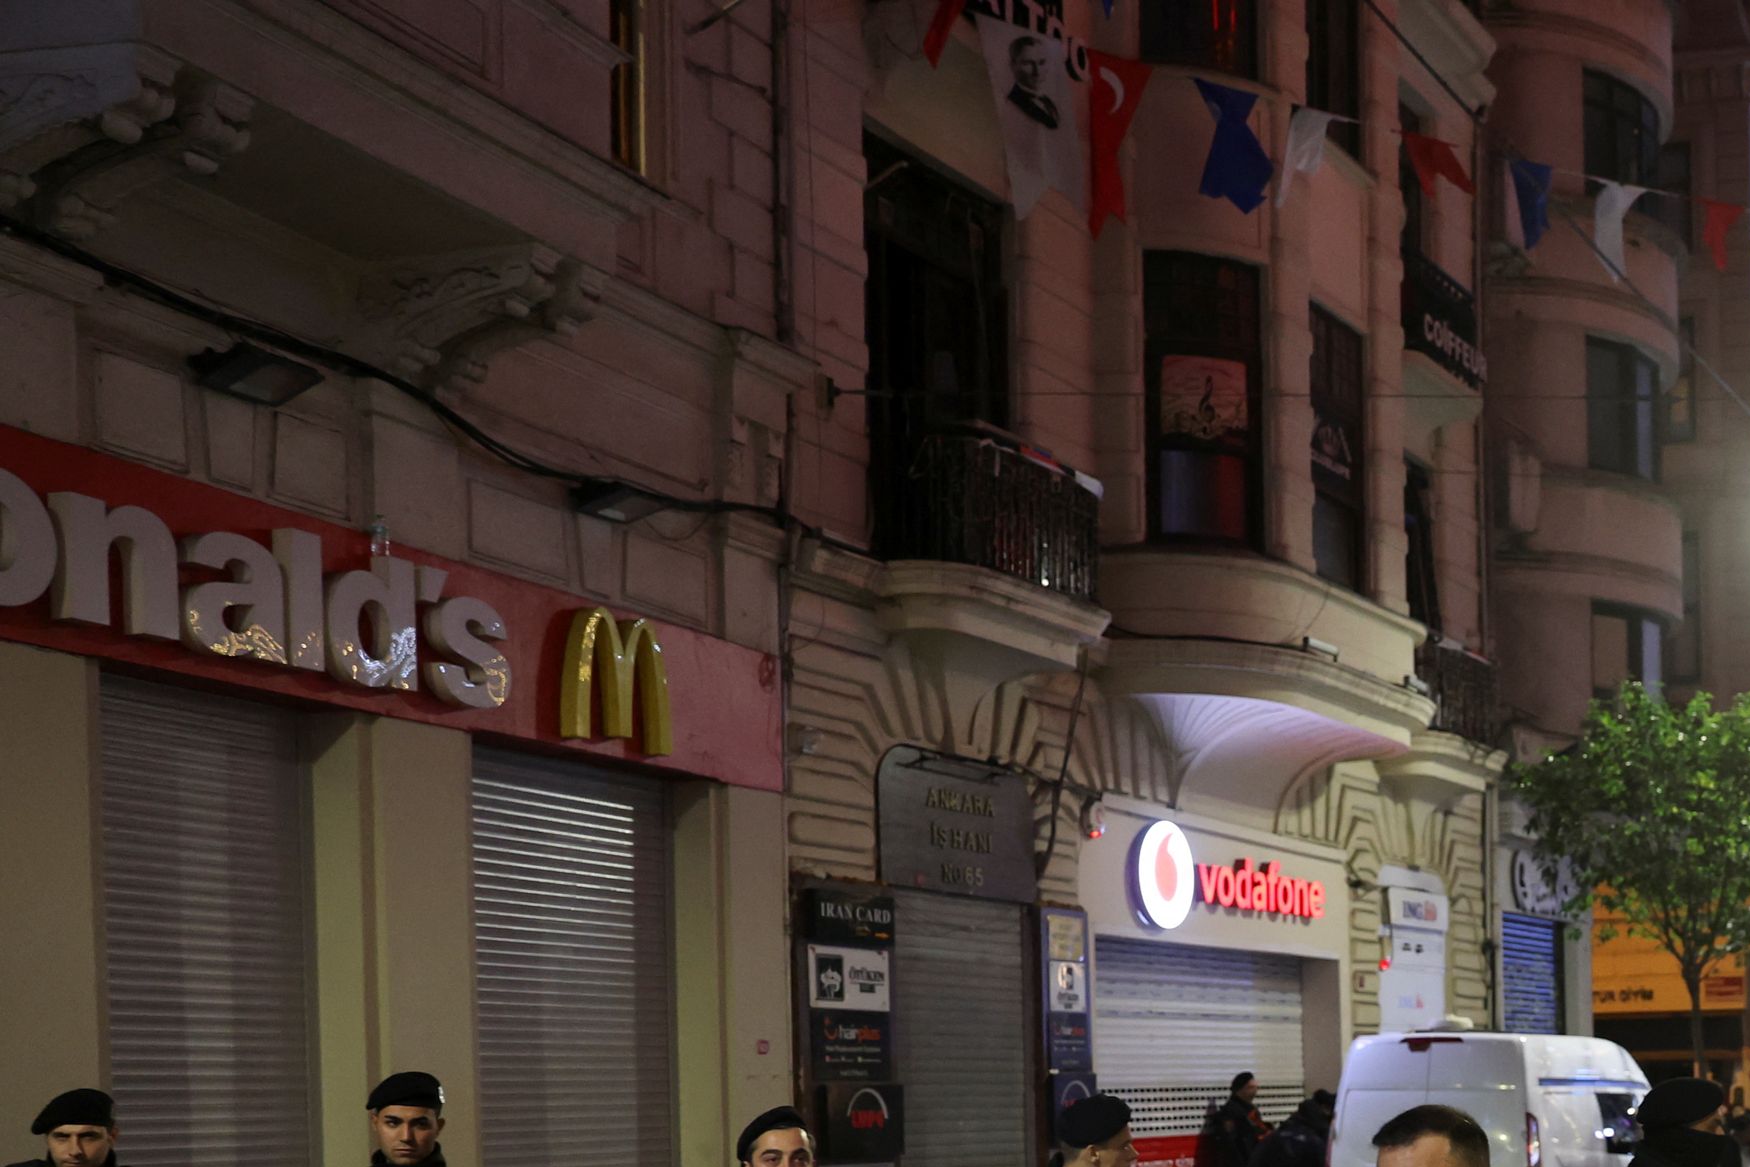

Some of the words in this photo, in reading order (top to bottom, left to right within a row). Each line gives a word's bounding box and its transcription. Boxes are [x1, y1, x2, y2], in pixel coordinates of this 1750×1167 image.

[926, 788, 994, 817] ANKARA
[964, 866, 984, 887] 65
[1198, 857, 1325, 919] vodafone
[820, 902, 853, 919] IRAN
[856, 906, 891, 924] CARD
[839, 1024, 880, 1043] hairplus
